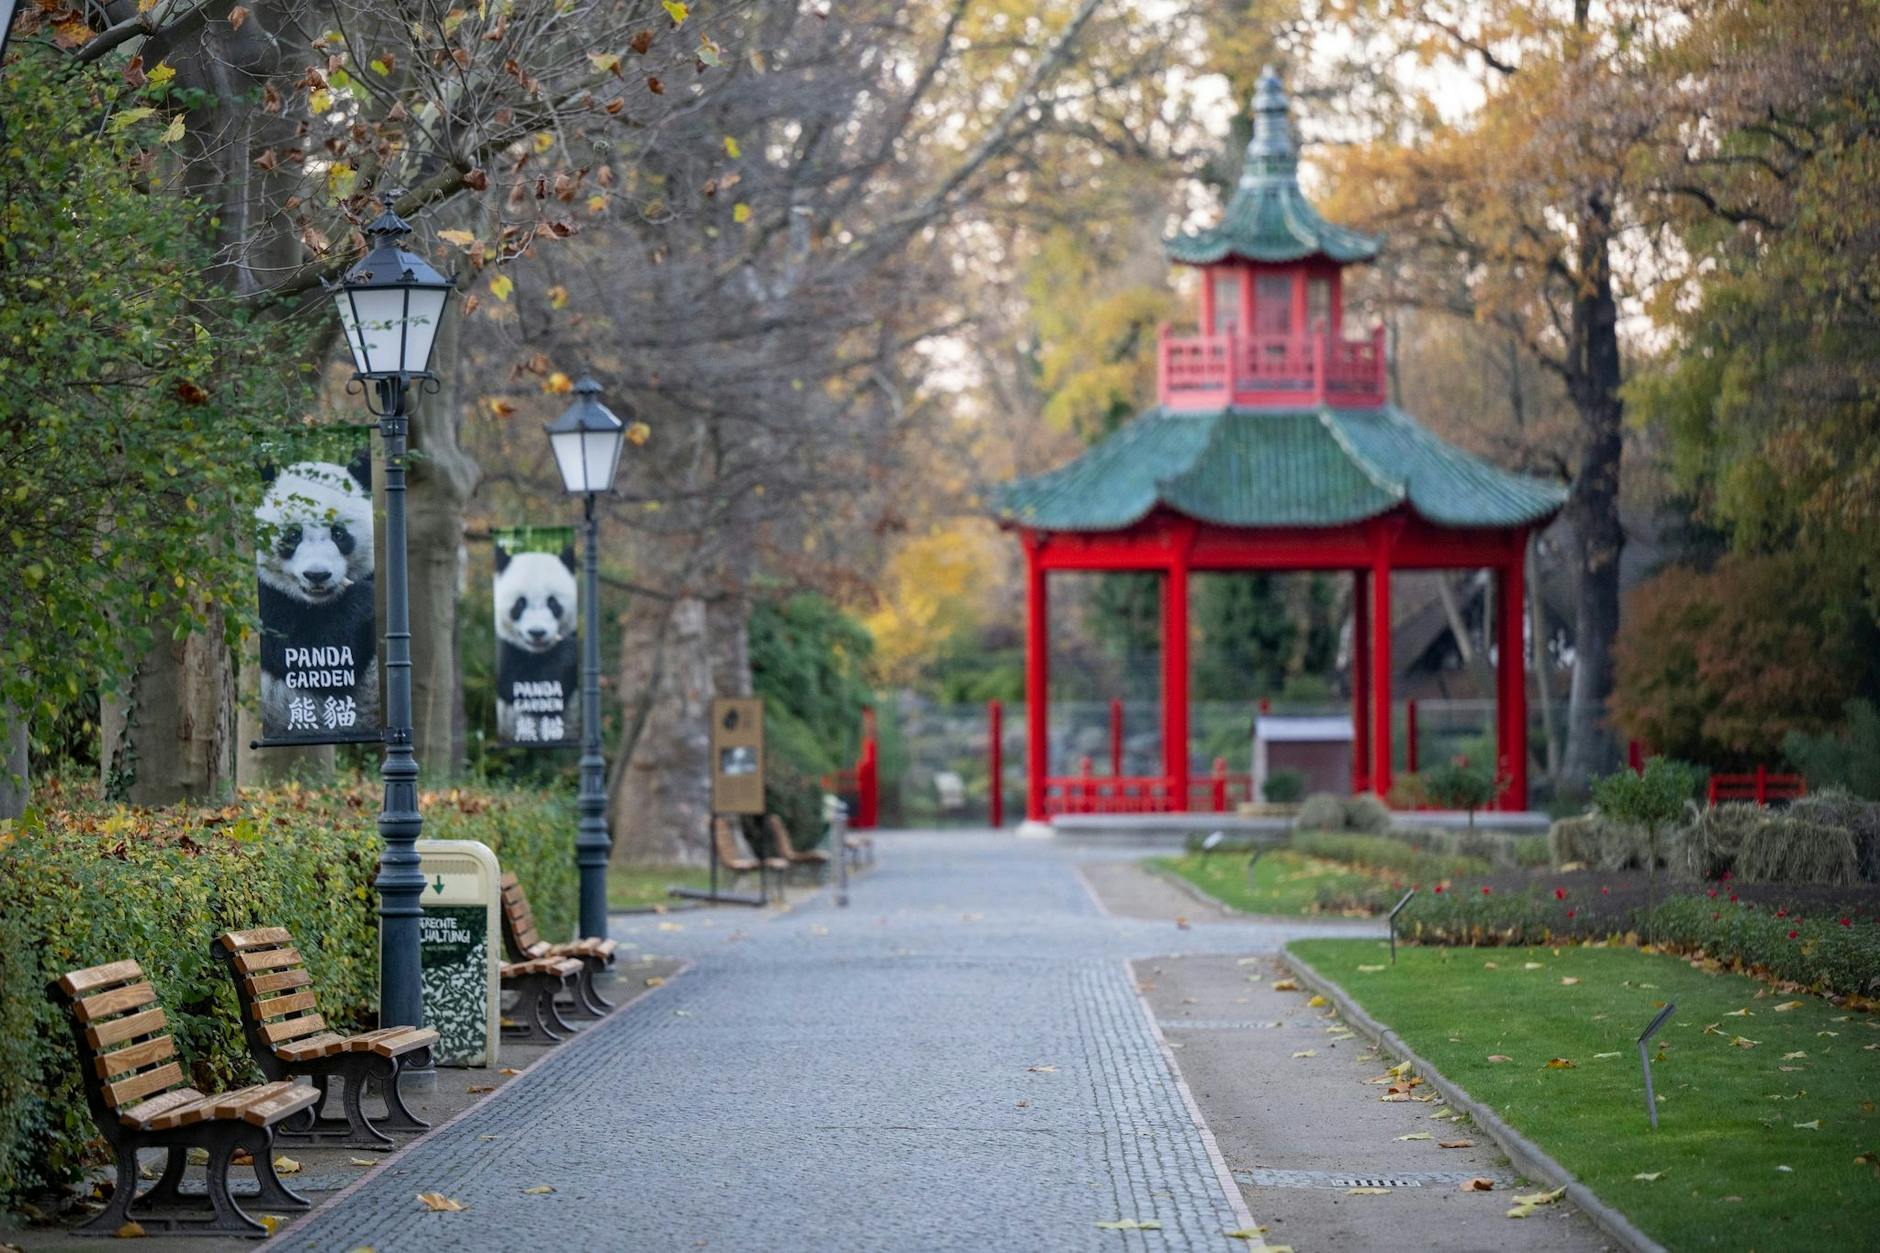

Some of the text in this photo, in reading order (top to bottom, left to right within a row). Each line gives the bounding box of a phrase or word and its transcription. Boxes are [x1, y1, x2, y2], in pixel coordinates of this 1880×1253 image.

[285, 646, 354, 668] PANDA
[285, 670, 355, 688] GARDEN
[513, 681, 563, 698] PANDA
[288, 695, 356, 730] 熊貓
